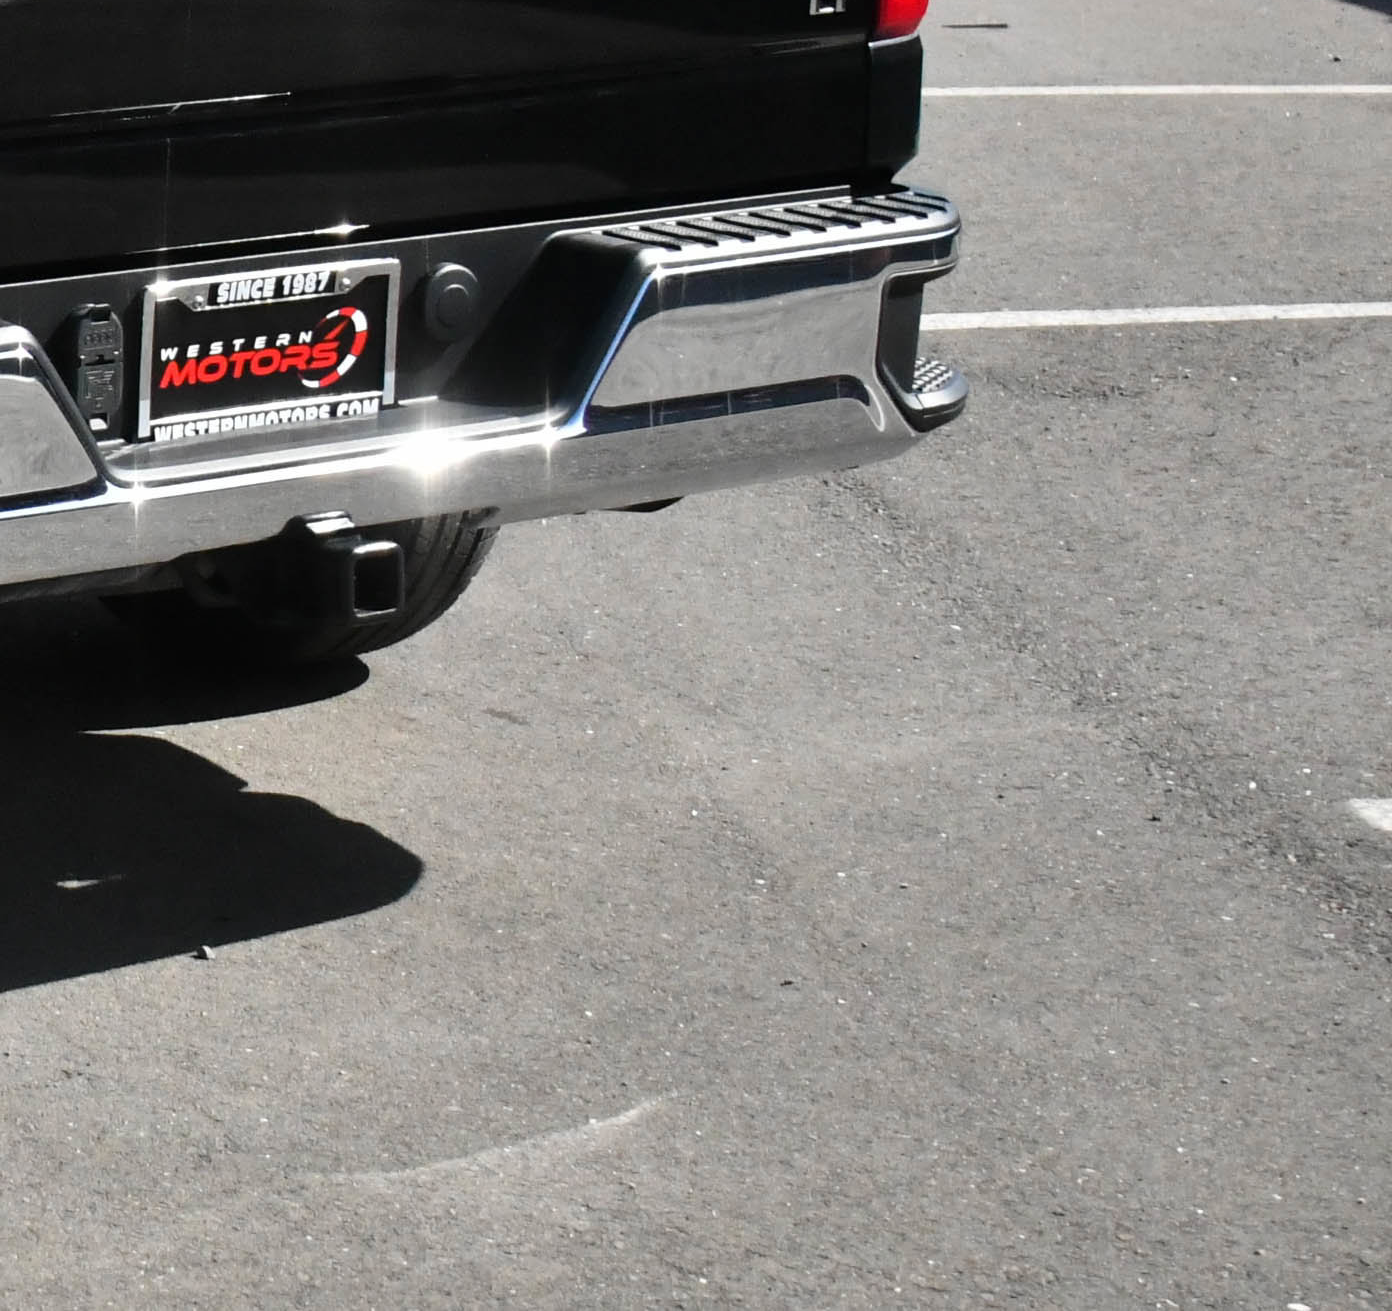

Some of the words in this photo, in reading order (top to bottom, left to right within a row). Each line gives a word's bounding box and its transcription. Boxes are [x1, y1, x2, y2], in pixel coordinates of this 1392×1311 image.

[216, 277, 275, 304] SINCE
[282, 270, 330, 297] 1987
[160, 330, 312, 362] WESTERN
[159, 341, 340, 389] MOTORS
